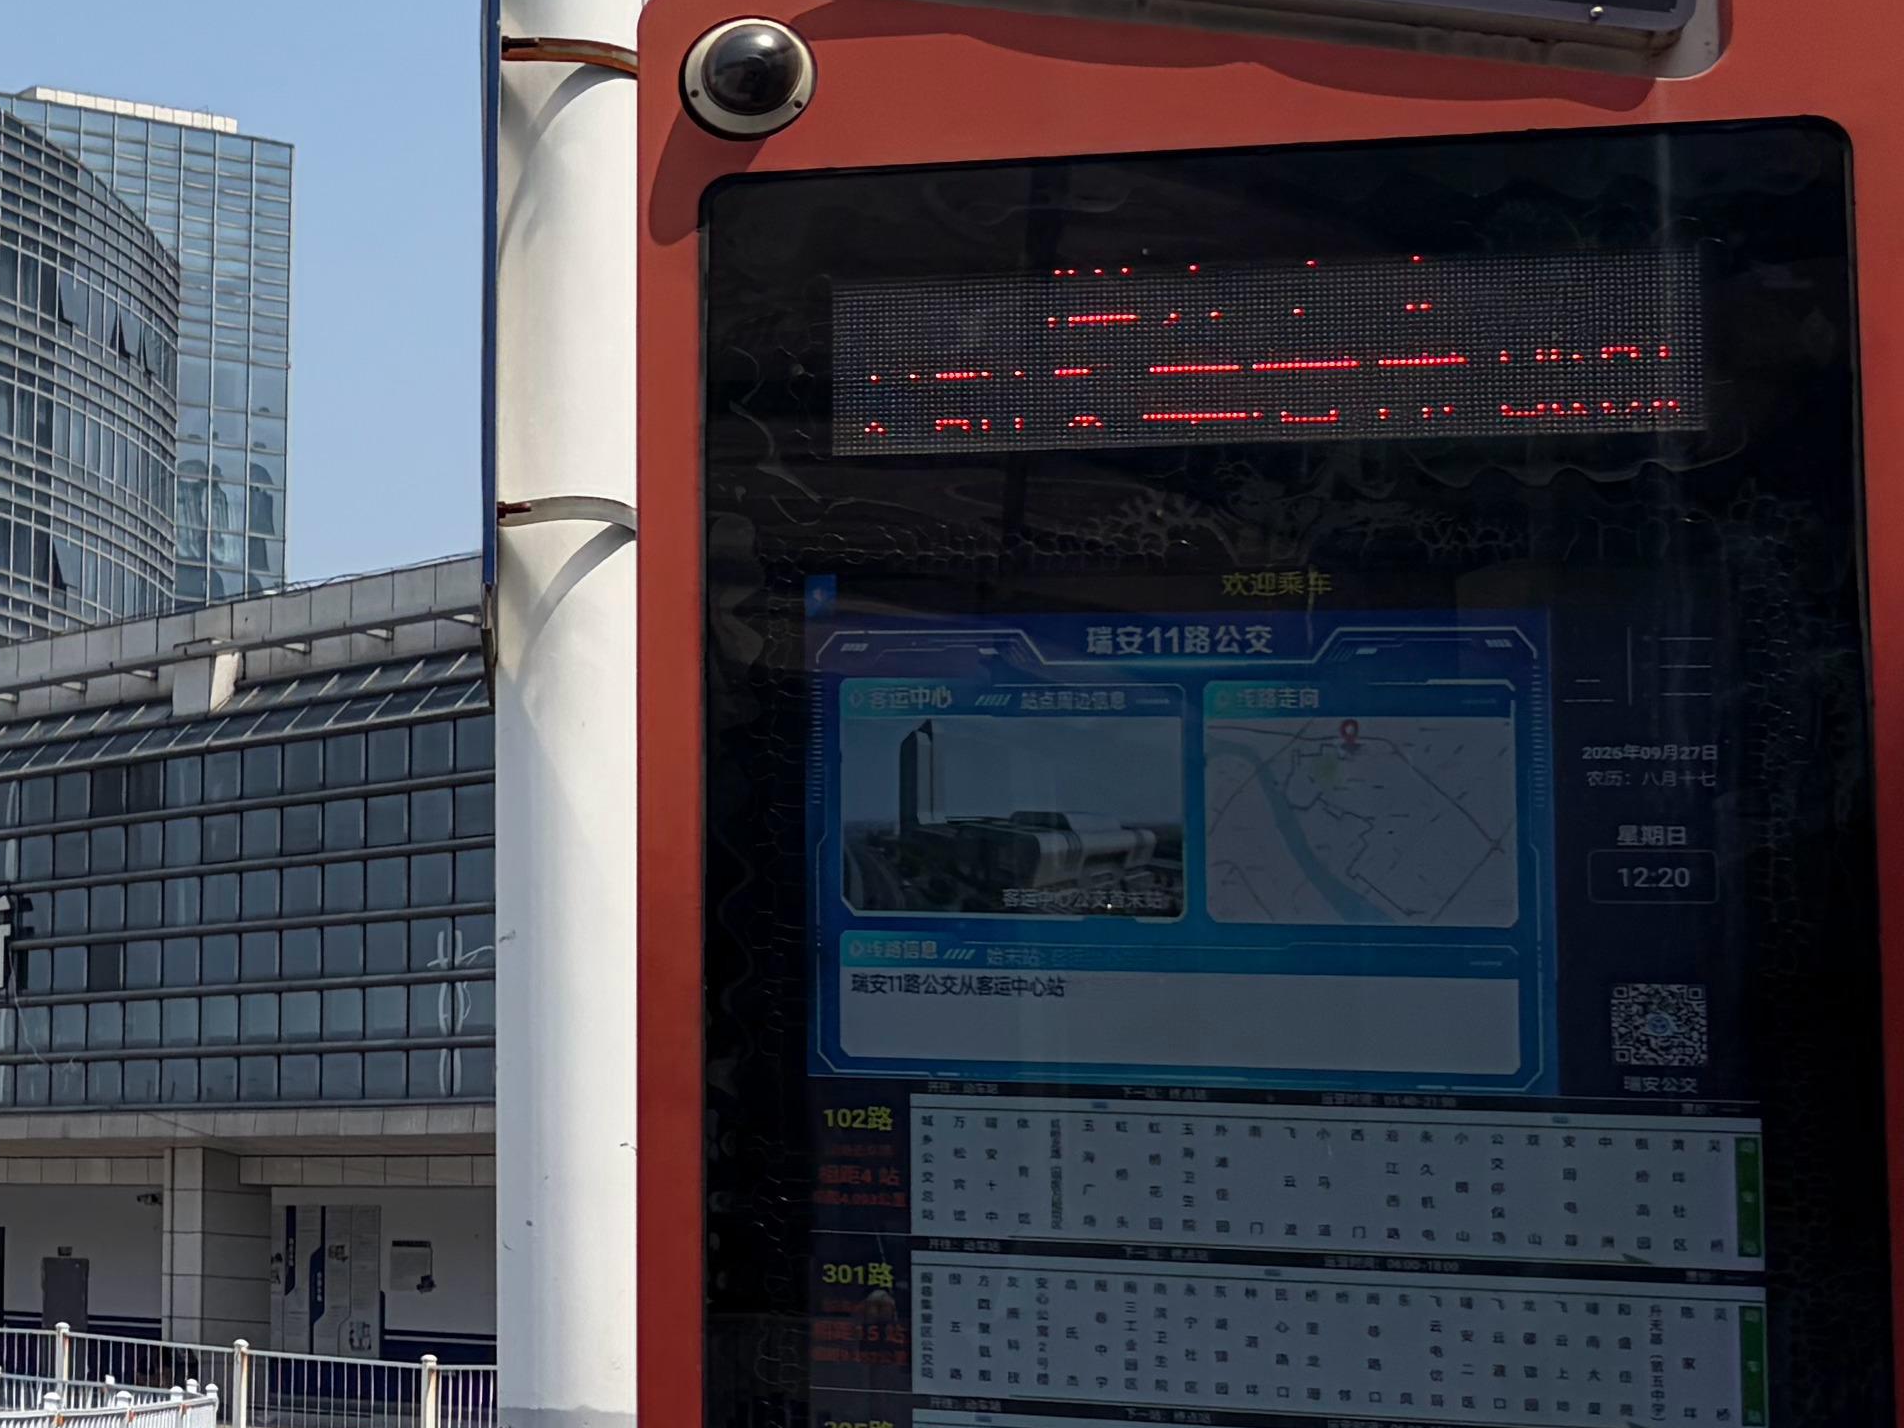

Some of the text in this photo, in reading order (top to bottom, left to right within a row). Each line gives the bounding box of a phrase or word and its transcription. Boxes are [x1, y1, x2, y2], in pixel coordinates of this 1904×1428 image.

[1222, 571, 1333, 597] 欢迎乘车
[1086, 625, 1273, 655] 瑞安11路公交
[1616, 824, 1687, 846] 星期日
[1617, 867, 1691, 888] 12:20
[851, 974, 1065, 998] 瑞安11路公交从客运中心站
[823, 1106, 893, 1131] 102路
[822, 1262, 894, 1288] 301路
